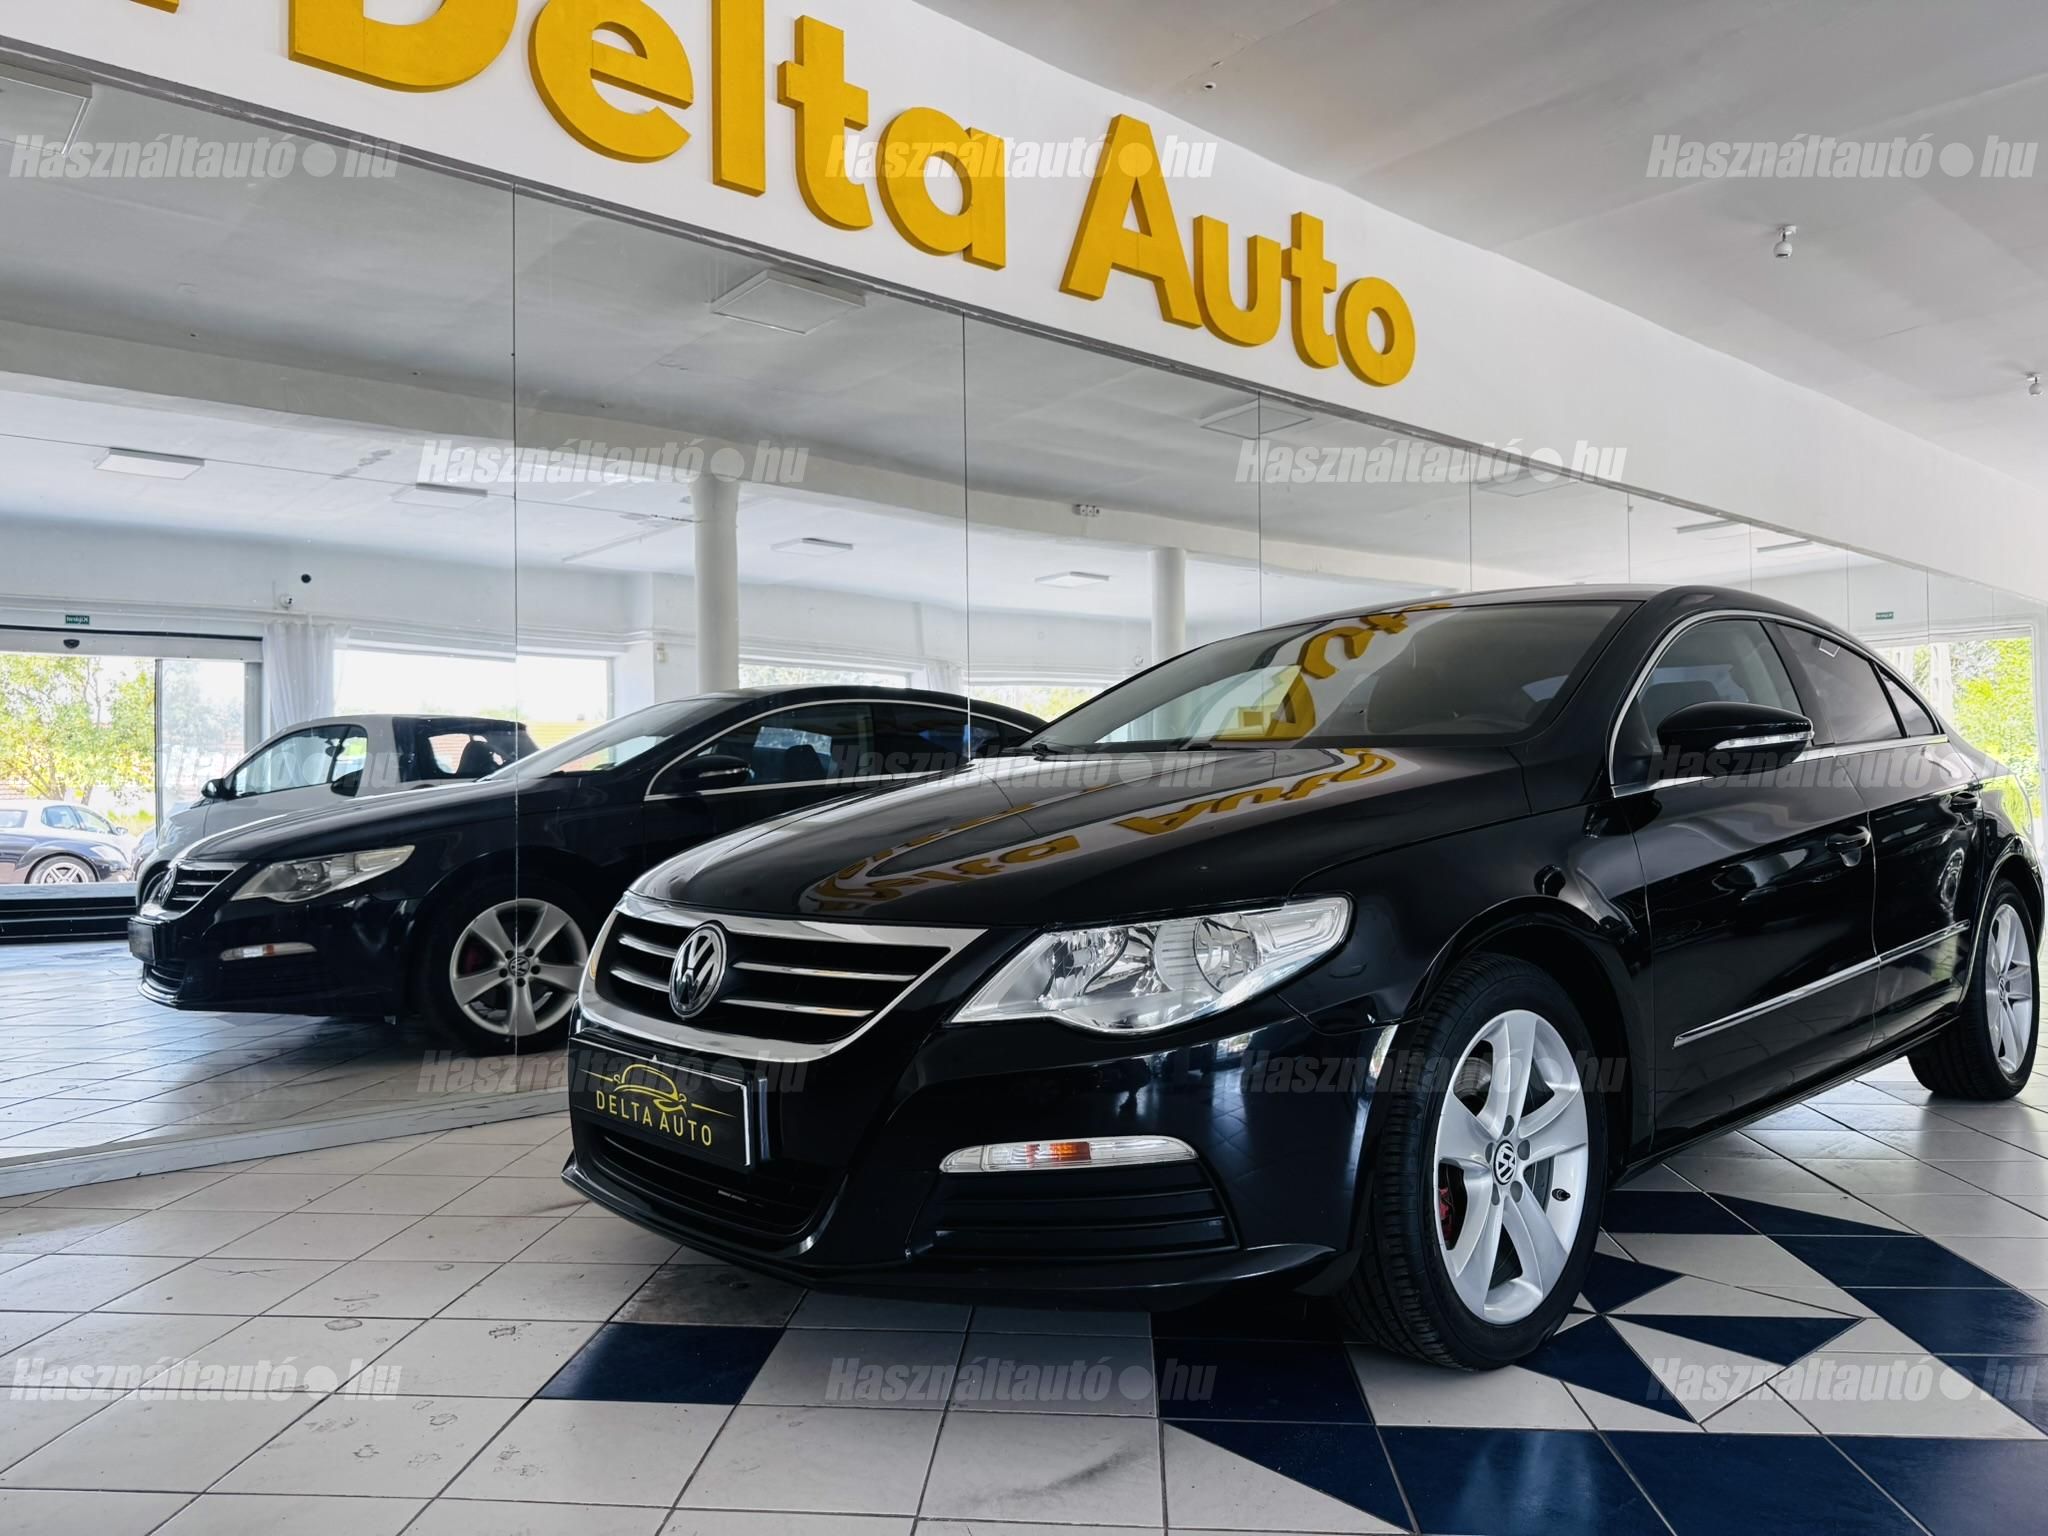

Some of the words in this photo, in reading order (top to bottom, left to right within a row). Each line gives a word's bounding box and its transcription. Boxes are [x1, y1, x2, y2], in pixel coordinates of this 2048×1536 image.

[288, 0, 1007, 271] elta
[1058, 114, 1416, 387] Auto
[595, 1090, 653, 1127] DELTA
[659, 1111, 712, 1146] AUTO
